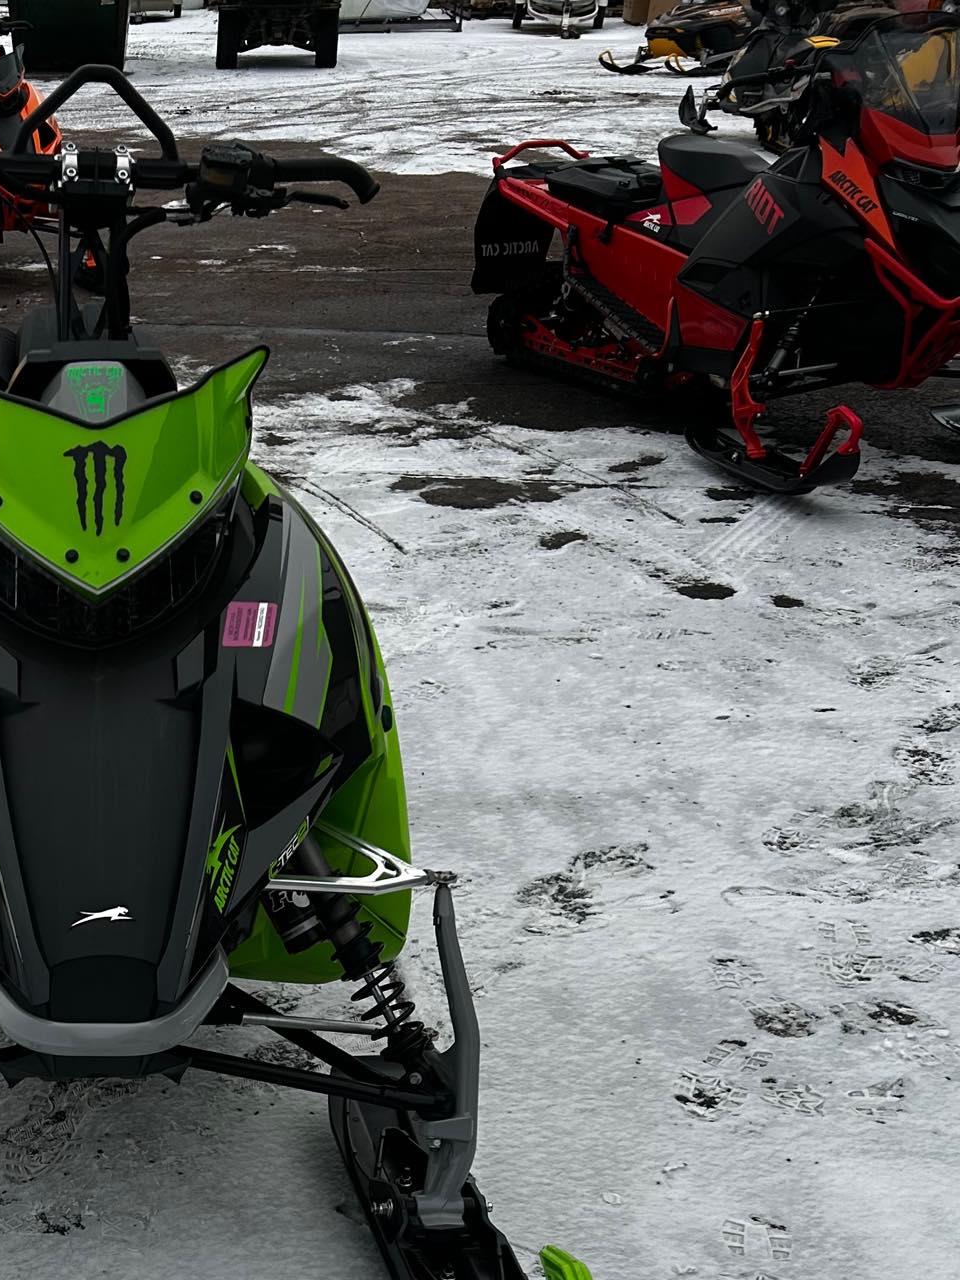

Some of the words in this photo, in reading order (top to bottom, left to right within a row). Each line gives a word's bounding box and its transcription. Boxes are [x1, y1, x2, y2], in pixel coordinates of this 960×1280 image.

[744, 178, 785, 236] RIOT
[828, 170, 863, 200] ARCTIC
[856, 195, 879, 214] CAT
[213, 858, 235, 915] ARCTIC
[227, 834, 240, 865] CAT
